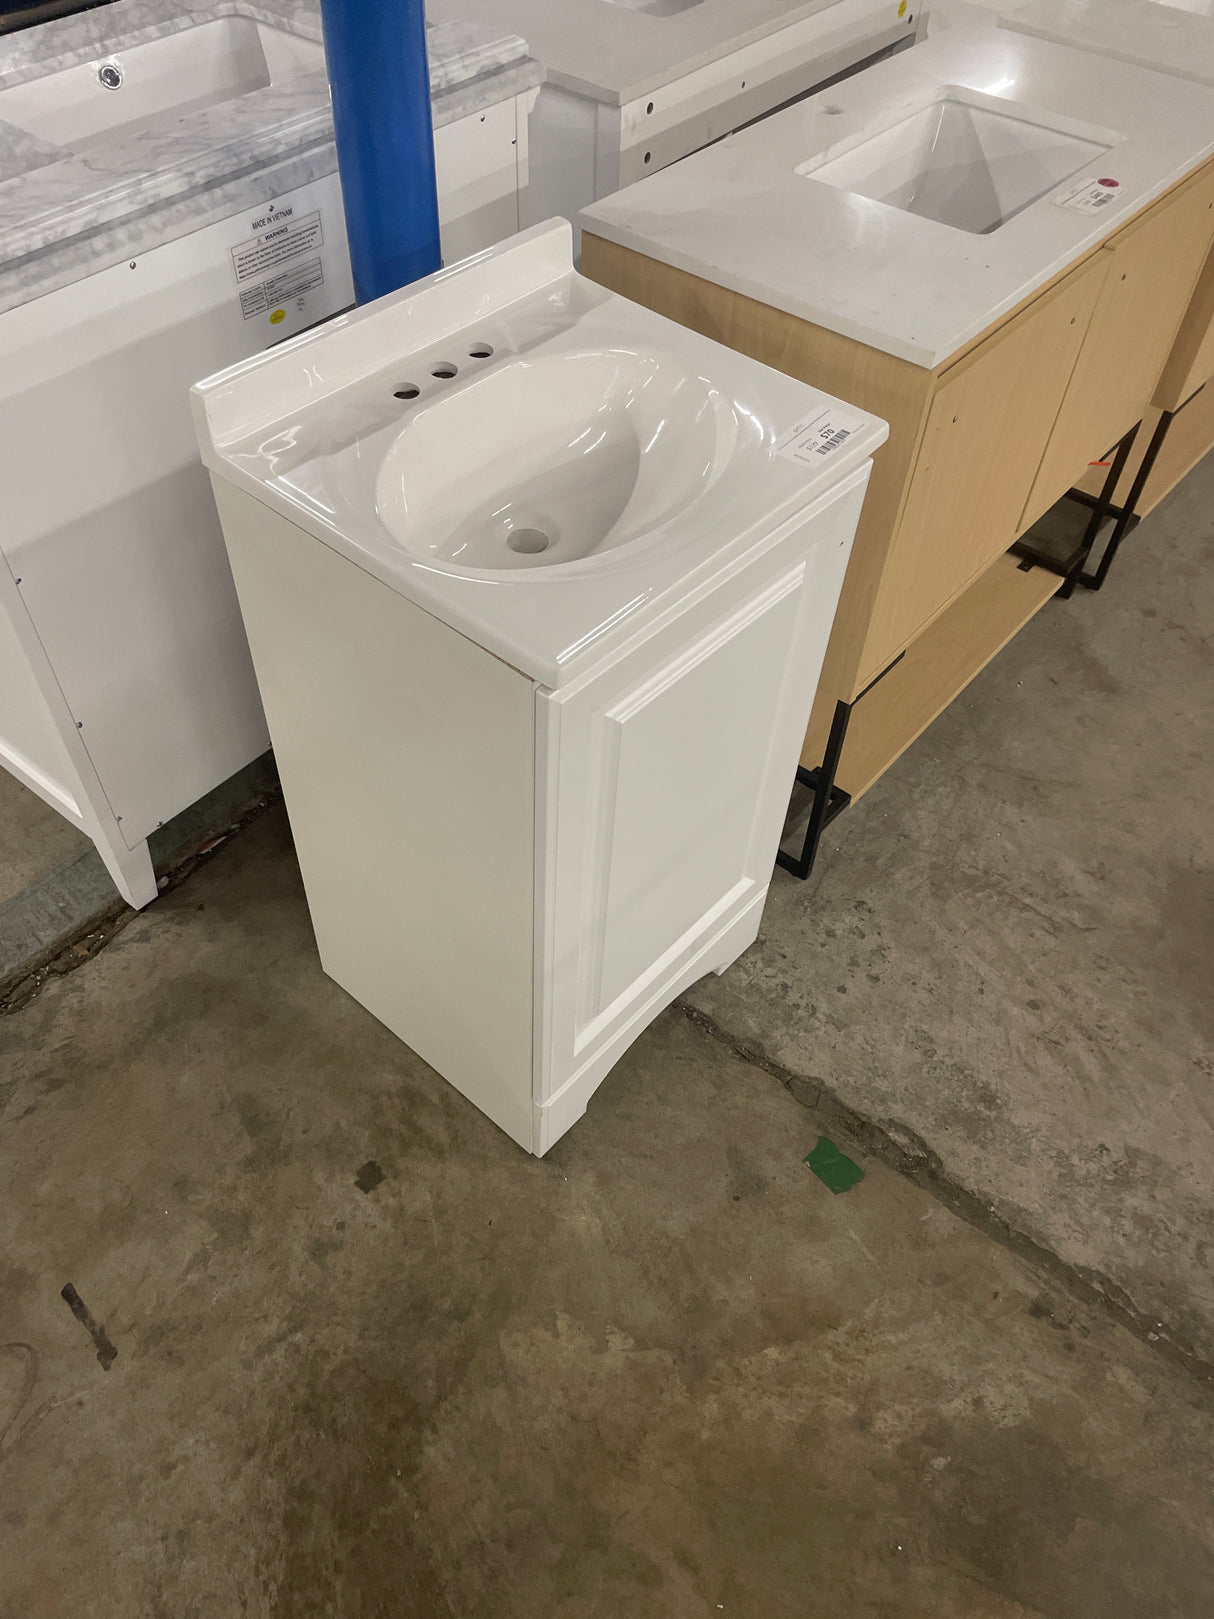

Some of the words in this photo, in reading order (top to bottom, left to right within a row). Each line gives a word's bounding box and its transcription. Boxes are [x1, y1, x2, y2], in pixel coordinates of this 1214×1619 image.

[252, 218, 266, 229] MADE
[267, 216, 273, 224] IN
[272, 208, 293, 221] VIETNAM
[265, 227, 288, 241] WARNING
[820, 428, 836, 439] $70
